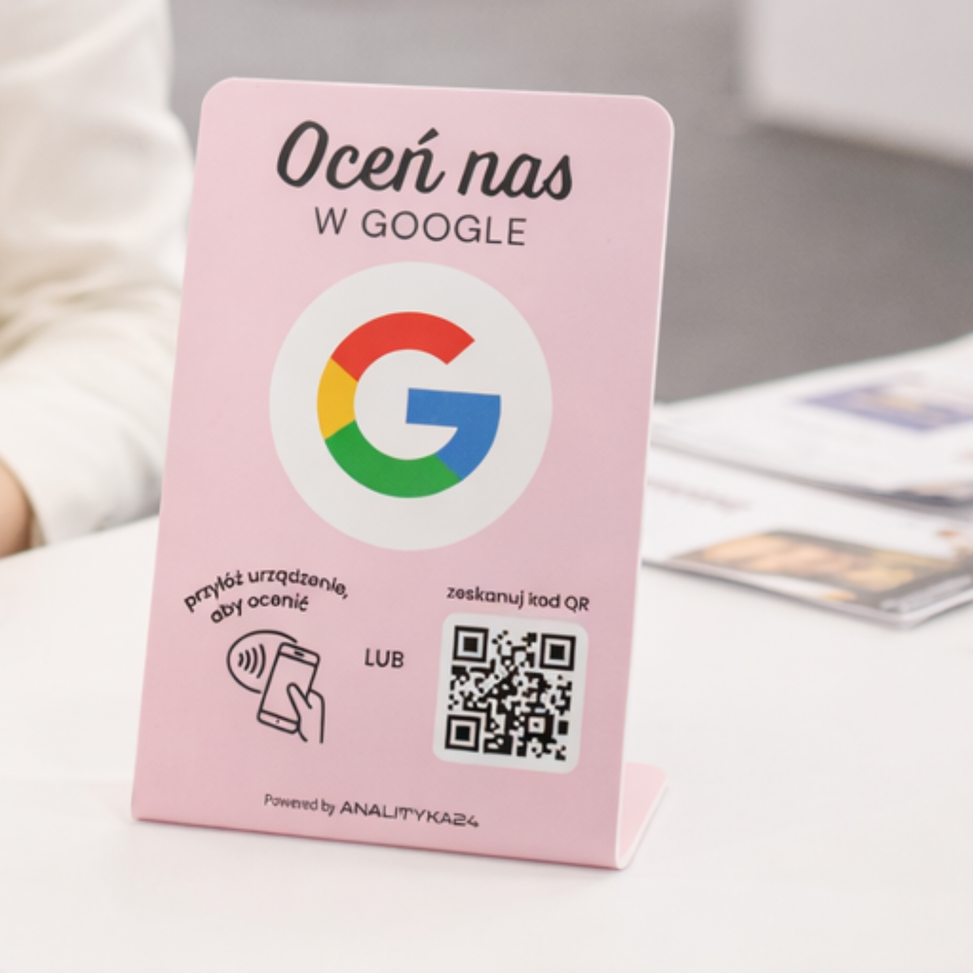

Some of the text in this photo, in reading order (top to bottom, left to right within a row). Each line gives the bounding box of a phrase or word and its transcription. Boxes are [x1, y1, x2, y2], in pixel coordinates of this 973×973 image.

[276, 119, 573, 201] Oceń nas
[314, 207, 528, 246] W GOOGLE
[210, 598, 243, 623] aby
[446, 586, 590, 613] zeskanuj kod QR
[364, 648, 405, 669] LUB
[263, 793, 480, 828] Powered by ANALITYKA24
